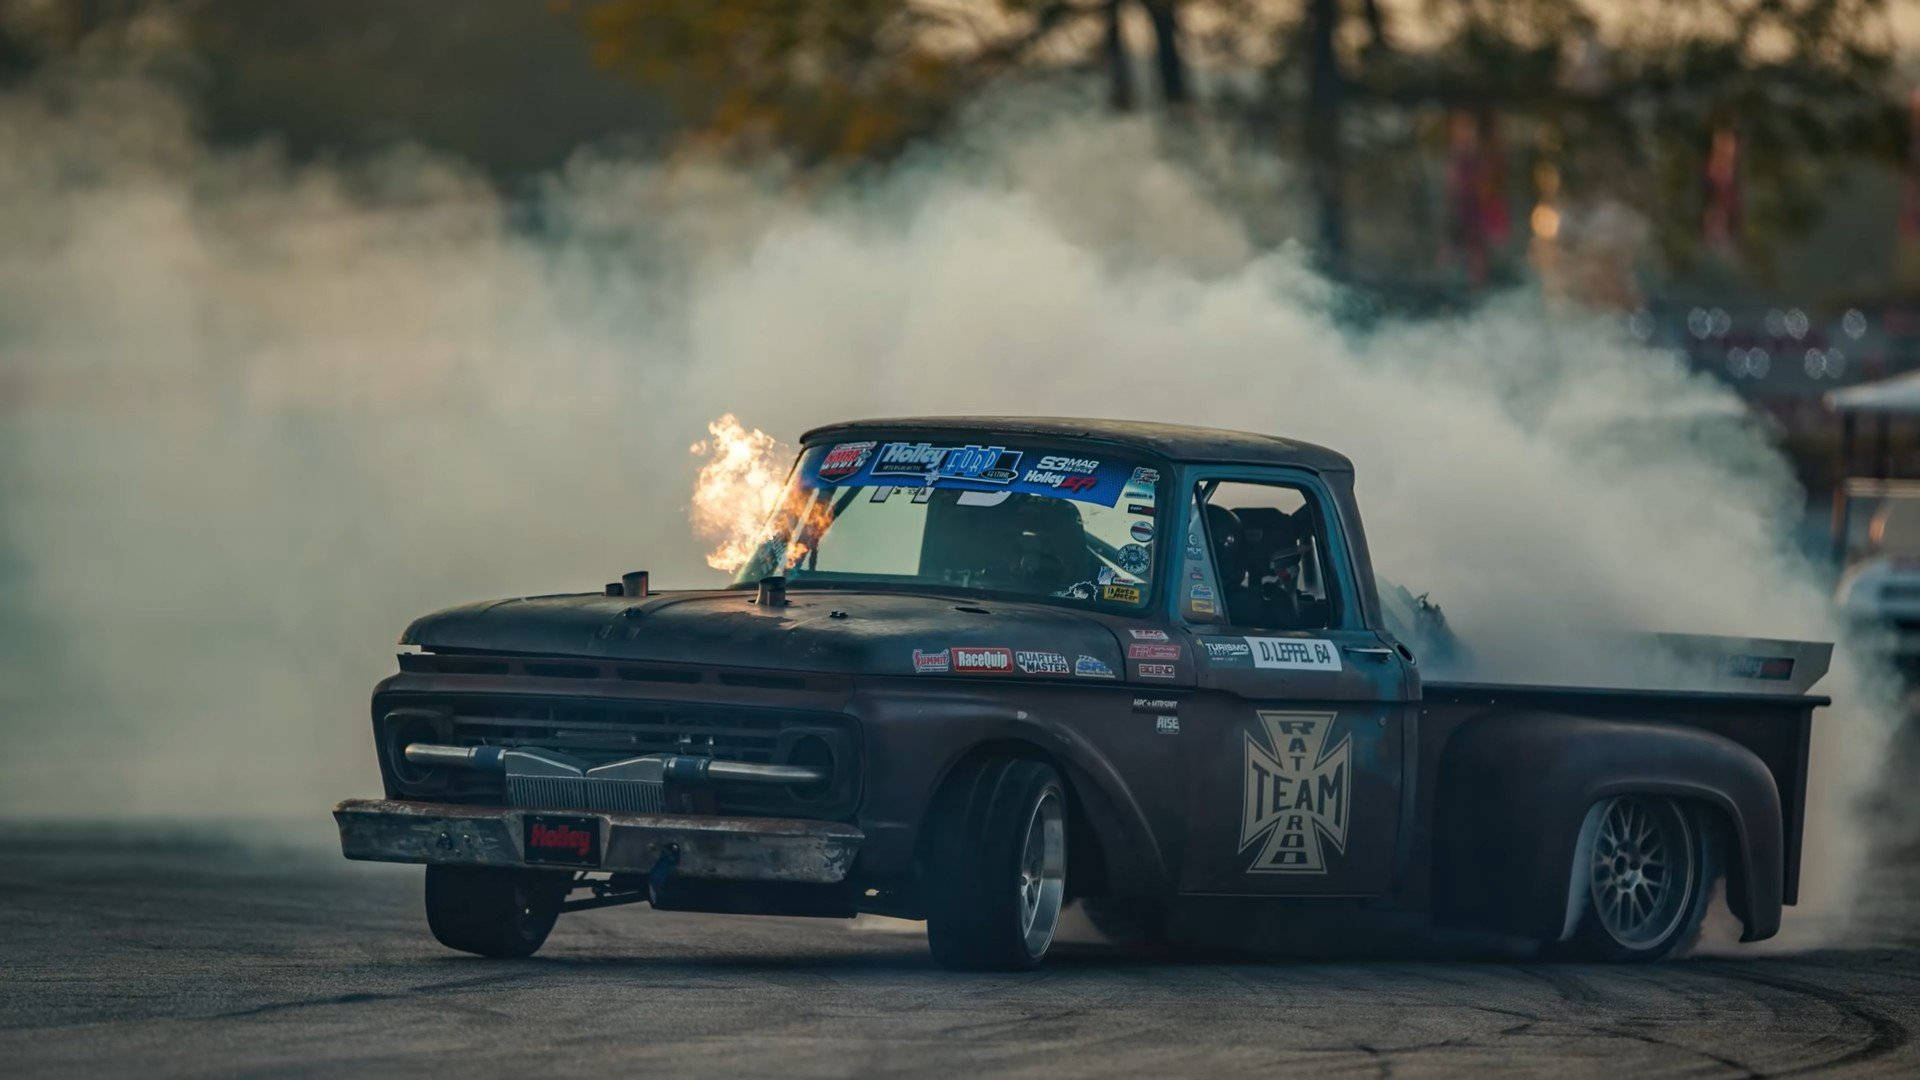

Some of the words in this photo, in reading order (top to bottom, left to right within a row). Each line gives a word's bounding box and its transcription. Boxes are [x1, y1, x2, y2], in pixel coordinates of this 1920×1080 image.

[882, 446, 947, 468] Holley
[947, 450, 996, 472] FORD
[1023, 470, 1066, 488] Holley
[1205, 643, 1249, 652] TURISMO
[1271, 642, 1314, 664] LEFFEL
[1315, 643, 1332, 664] 64
[958, 651, 1008, 668] RaceQuip
[1018, 653, 1065, 666] QUARTER
[1026, 663, 1069, 673] MASTER
[1157, 716, 1180, 729] RISE
[1279, 721, 1316, 771] RAT
[1253, 761, 1345, 829] TEAM
[530, 824, 592, 857] Holley
[1270, 815, 1309, 864] ROD
